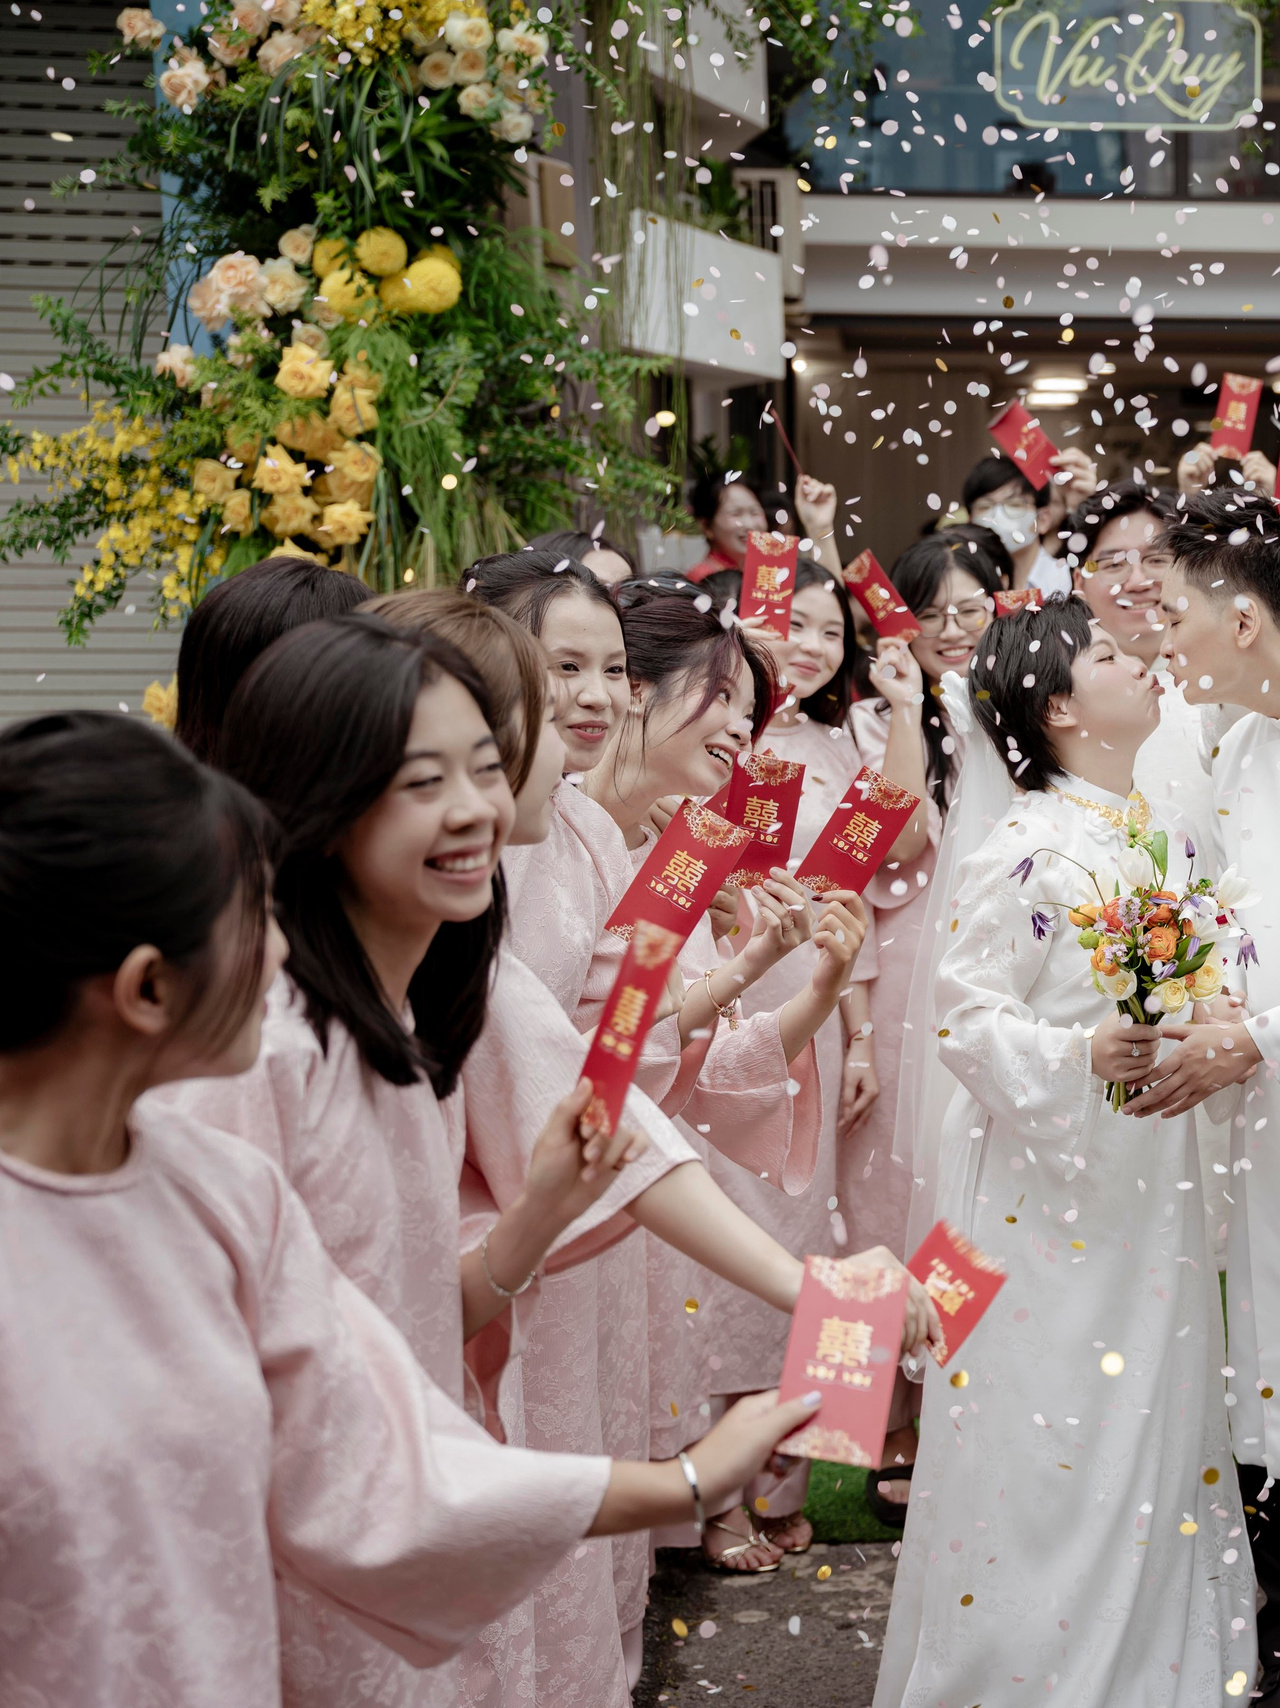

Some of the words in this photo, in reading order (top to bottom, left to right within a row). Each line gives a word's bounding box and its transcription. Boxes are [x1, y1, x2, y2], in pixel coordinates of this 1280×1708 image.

[1009, 11, 1120, 104] Vu
[1118, 12, 1246, 120] Quy
[744, 796, 780, 831] 囍
[844, 811, 883, 850] 囍
[661, 850, 707, 895] 囍
[815, 1315, 875, 1368] 囍
